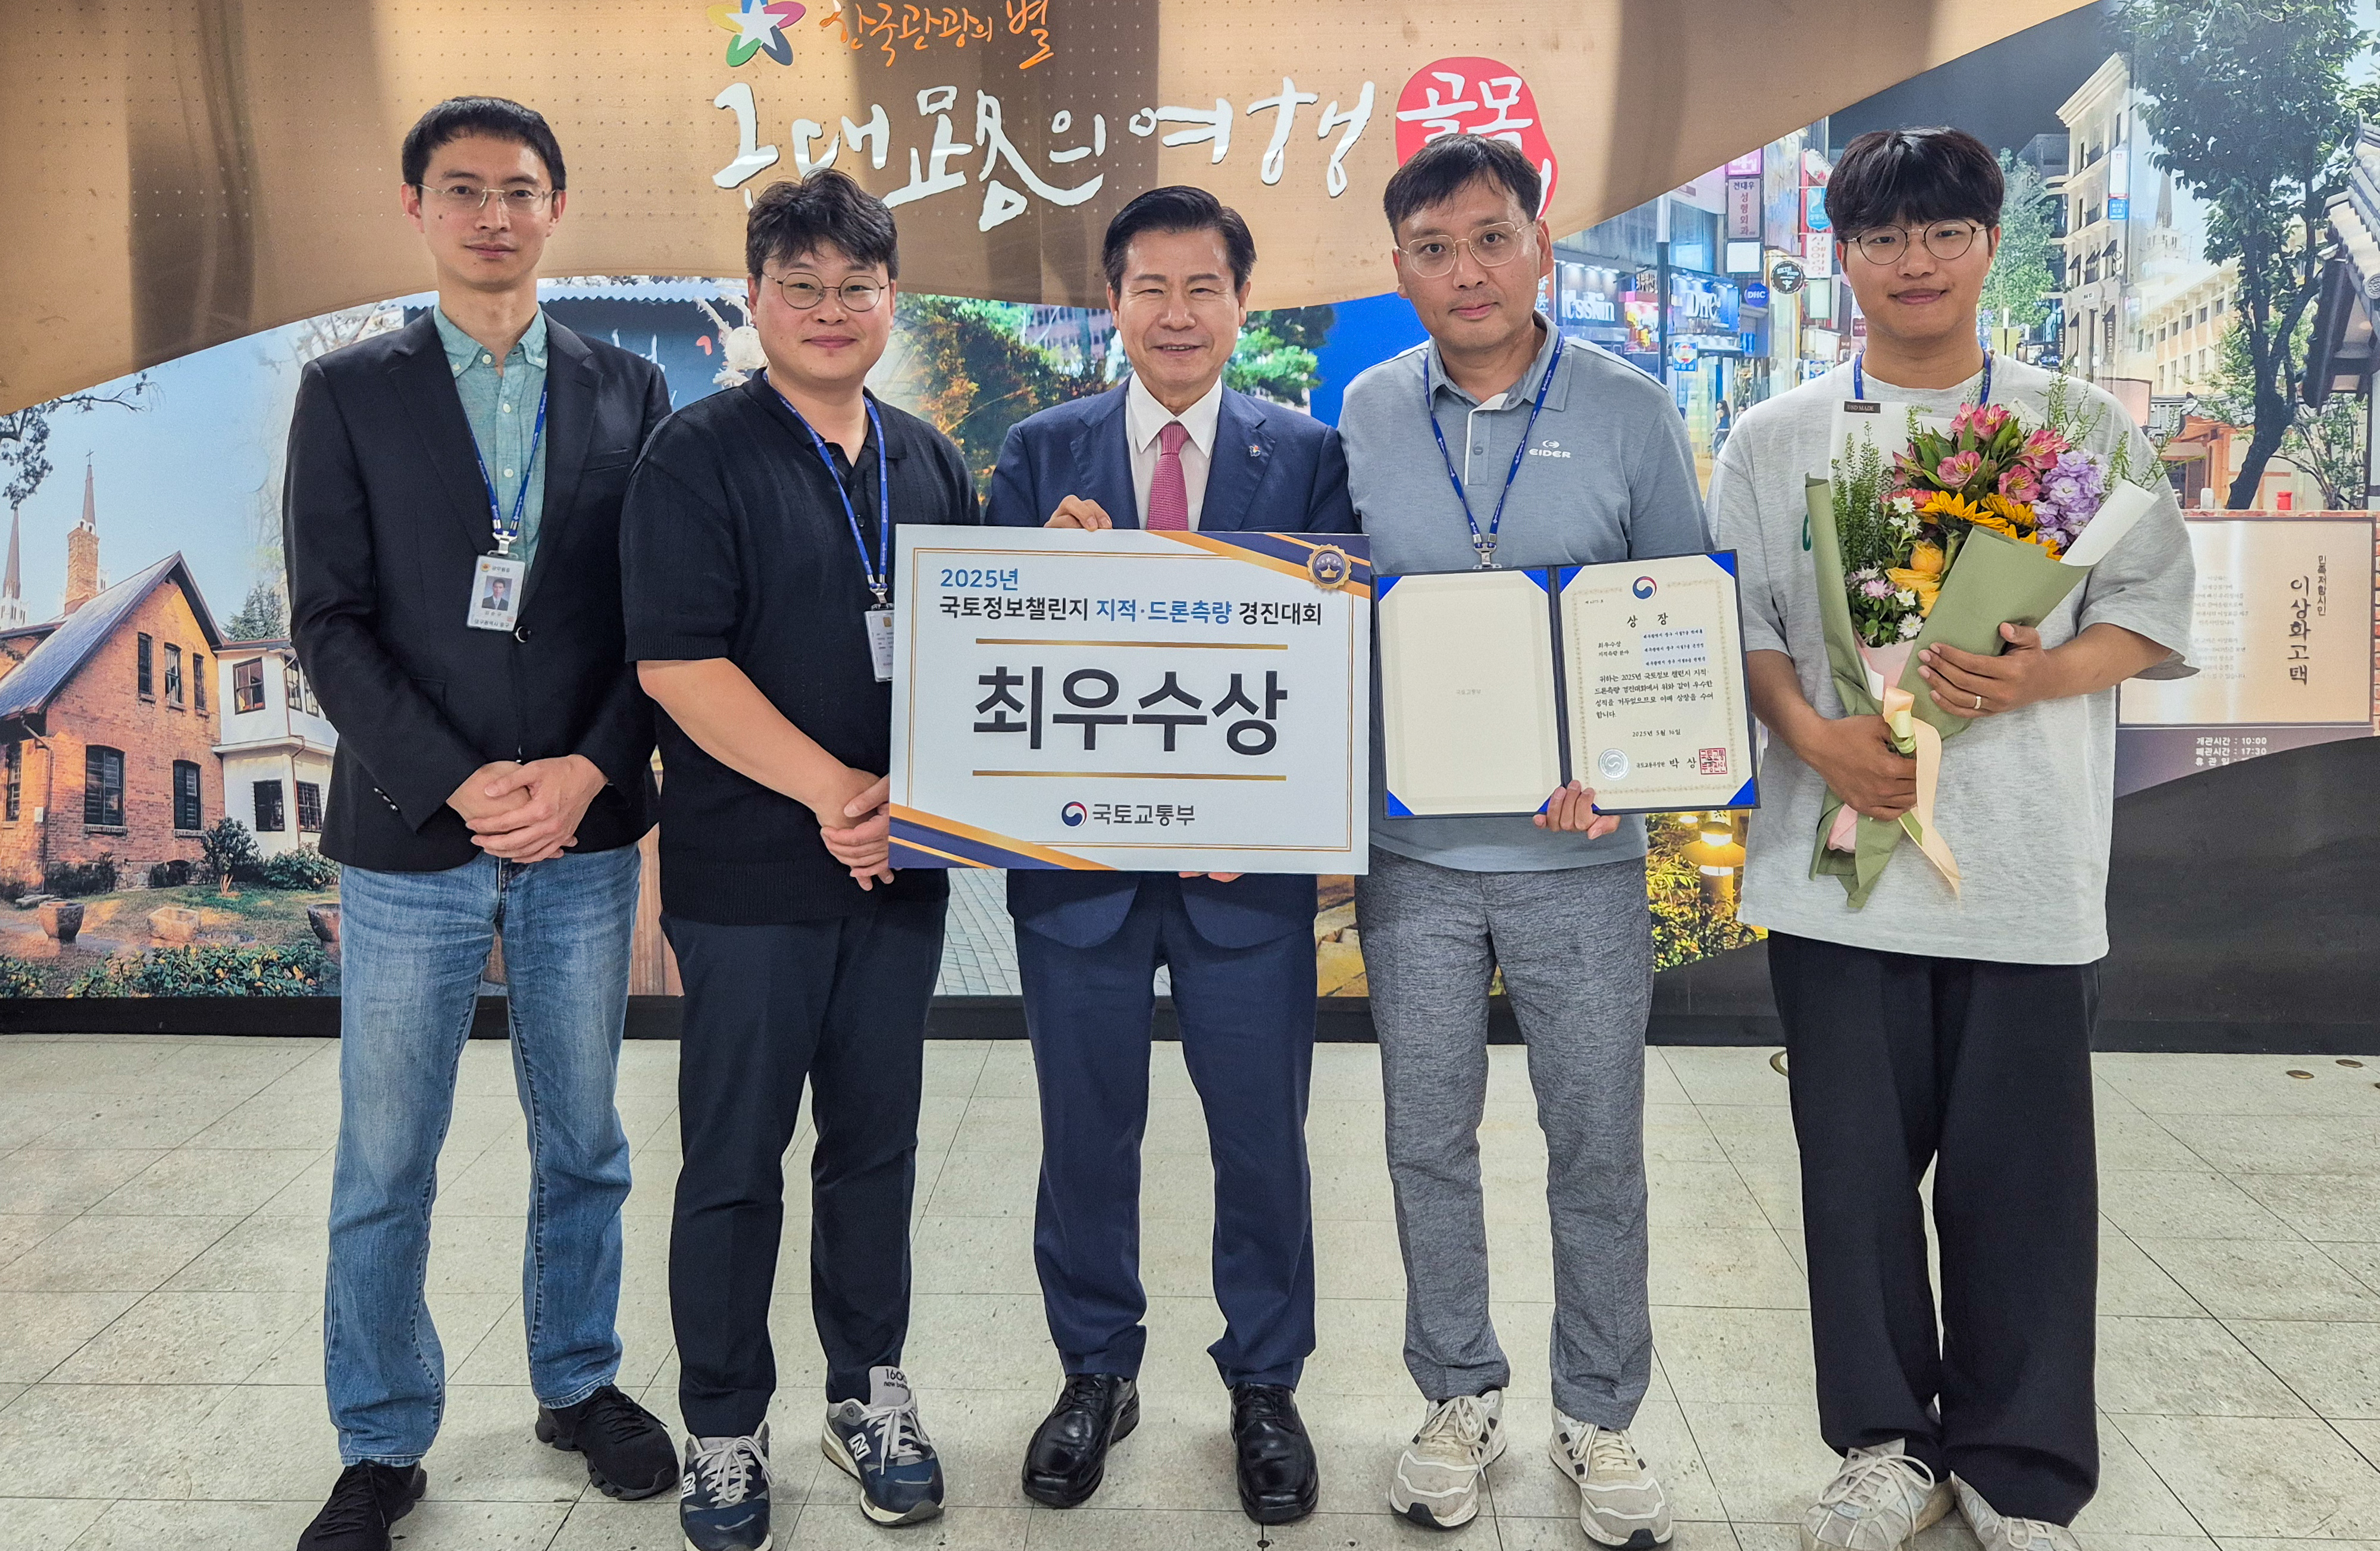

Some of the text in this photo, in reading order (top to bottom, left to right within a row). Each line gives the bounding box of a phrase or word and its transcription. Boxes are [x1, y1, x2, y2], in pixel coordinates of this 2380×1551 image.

[819, 0, 1054, 69] 한국관광의 별
[1129, 76, 1376, 198] 여행
[1740, 192, 1749, 236] 성형외과
[1529, 448, 1571, 458] EIDER
[940, 568, 1019, 592] 2025년
[2317, 555, 2327, 617] 민족저항시인
[939, 596, 1089, 621] 국토정보챌린지
[1238, 602, 1322, 627] 경진대회
[1627, 612, 1668, 628] 상 장
[1599, 674, 1619, 683] 귀하는
[1644, 671, 1669, 680] 국토정보
[1671, 669, 1691, 678] 챌린지
[1595, 680, 1713, 695] 드론측량 경진대회에서 위와 같이 우수한
[1595, 692, 1714, 707] 성적을 거두었으므로 이에 상장을 수여
[973, 665, 1289, 756] 최우수상
[1596, 710, 1617, 719] 합니다.
[2196, 737, 2231, 746] 개관시간
[1669, 757, 1680, 769] 박
[1687, 756, 1697, 769] 상
[1091, 803, 1196, 827] 국토교통부
